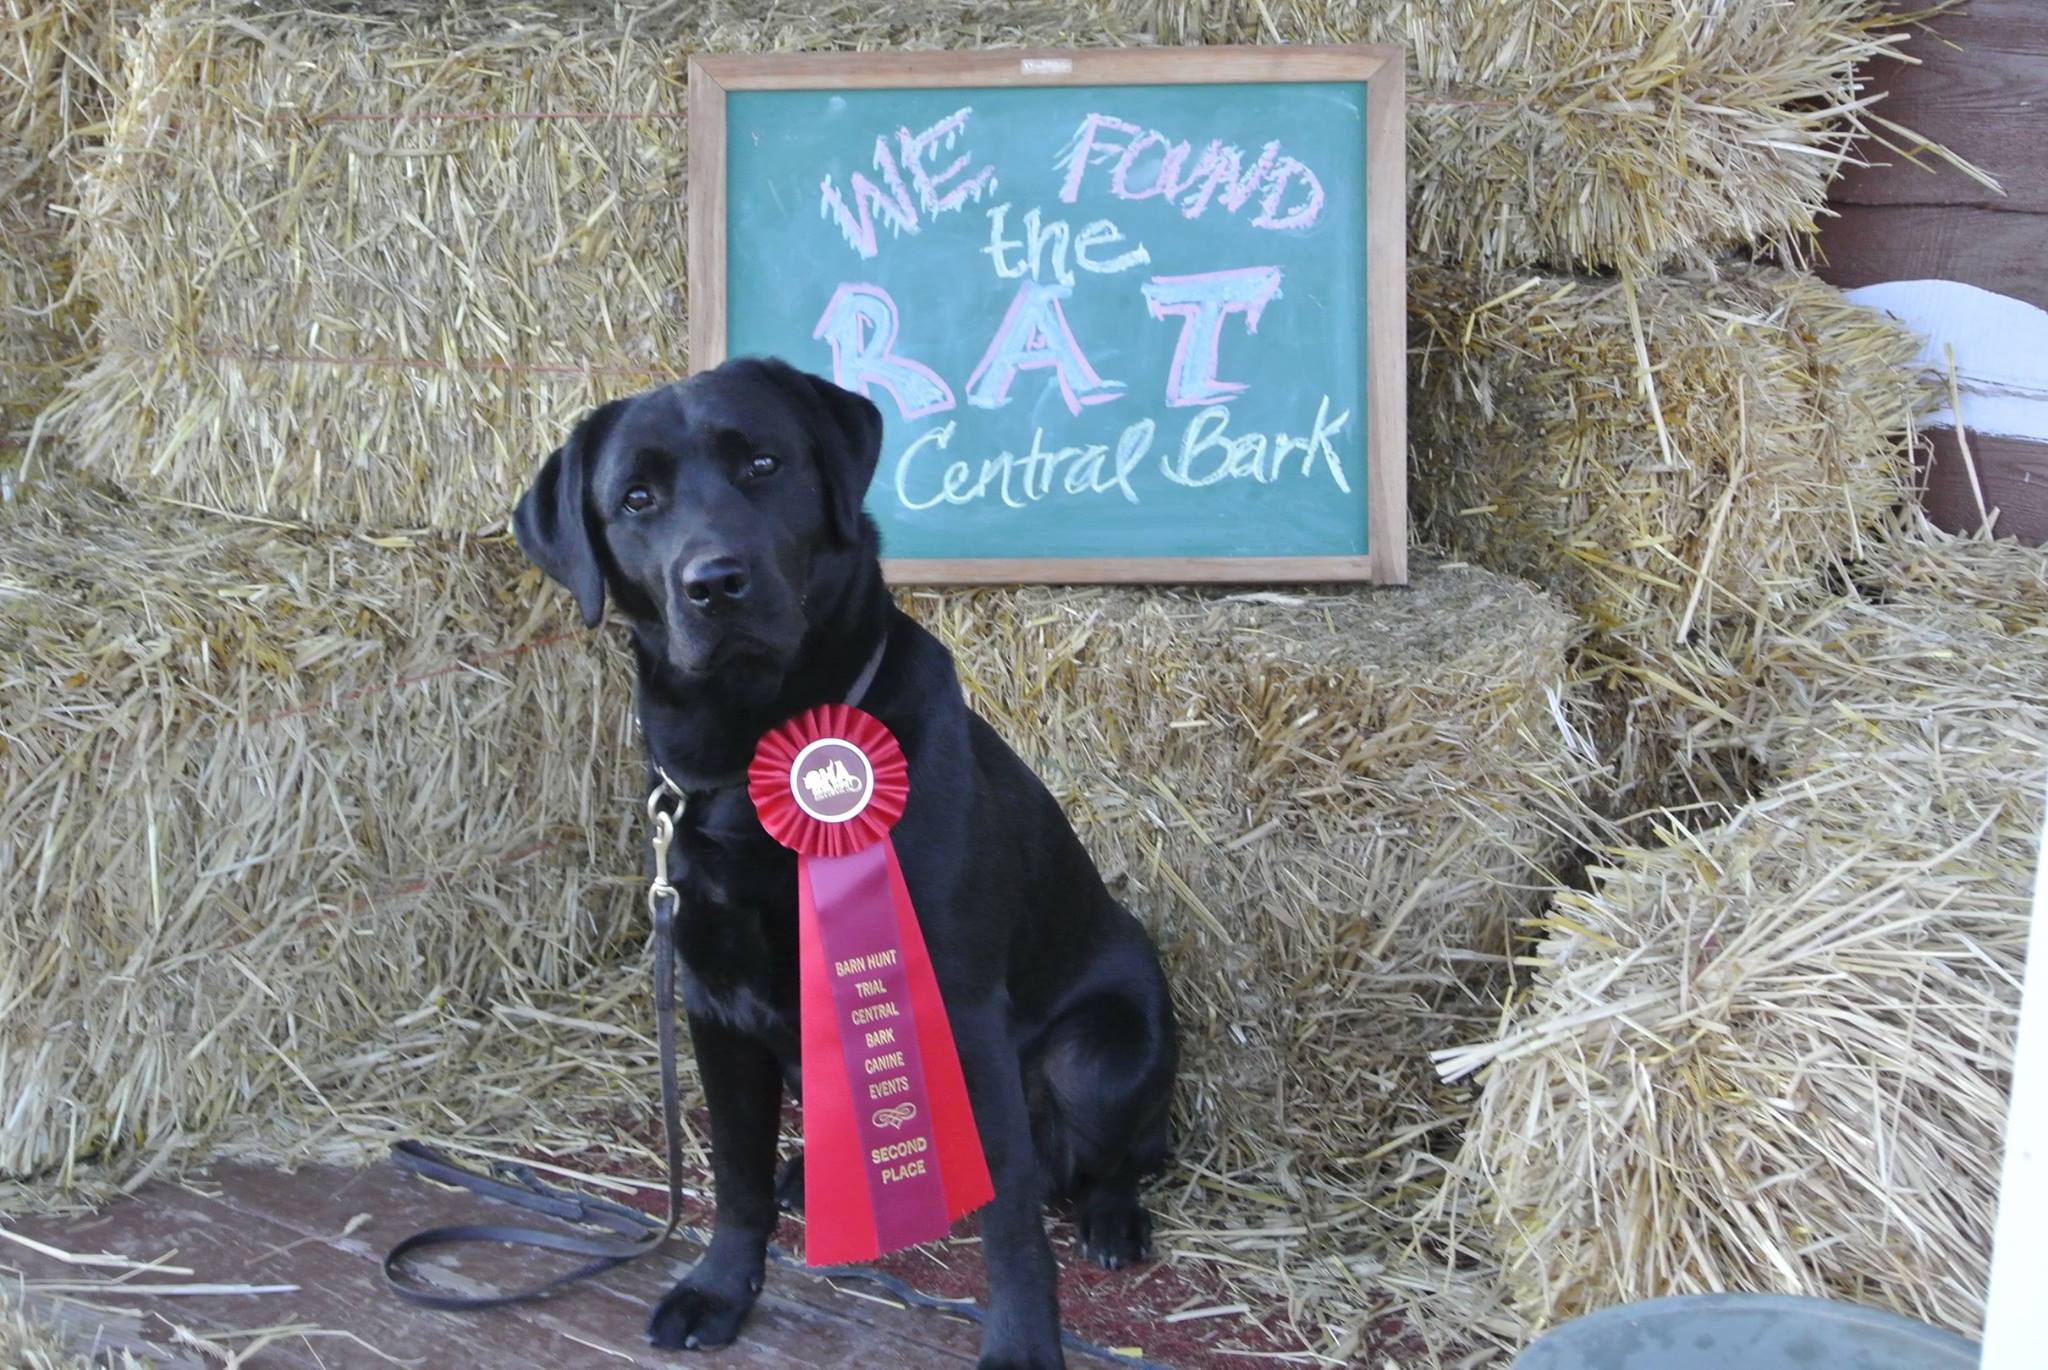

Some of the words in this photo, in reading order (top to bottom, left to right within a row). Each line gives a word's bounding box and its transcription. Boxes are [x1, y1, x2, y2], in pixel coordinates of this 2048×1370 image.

[820, 106, 998, 258] WE
[1053, 113, 1325, 229] FOUND
[983, 203, 1150, 286] the
[813, 266, 1282, 419] RAT
[896, 419, 1155, 510] Central
[1162, 395, 1351, 494] Bark
[835, 956, 866, 977] BARN
[867, 949, 897, 969] HUNT
[855, 980, 886, 998] TRIAL
[851, 1002, 899, 1025] CENTRAL
[865, 1028, 895, 1048] BARK
[865, 1052, 905, 1074] CANINE
[869, 1076, 909, 1099] EVENTS
[872, 1137, 928, 1164] SECOND
[881, 1160, 926, 1184] PLACE
